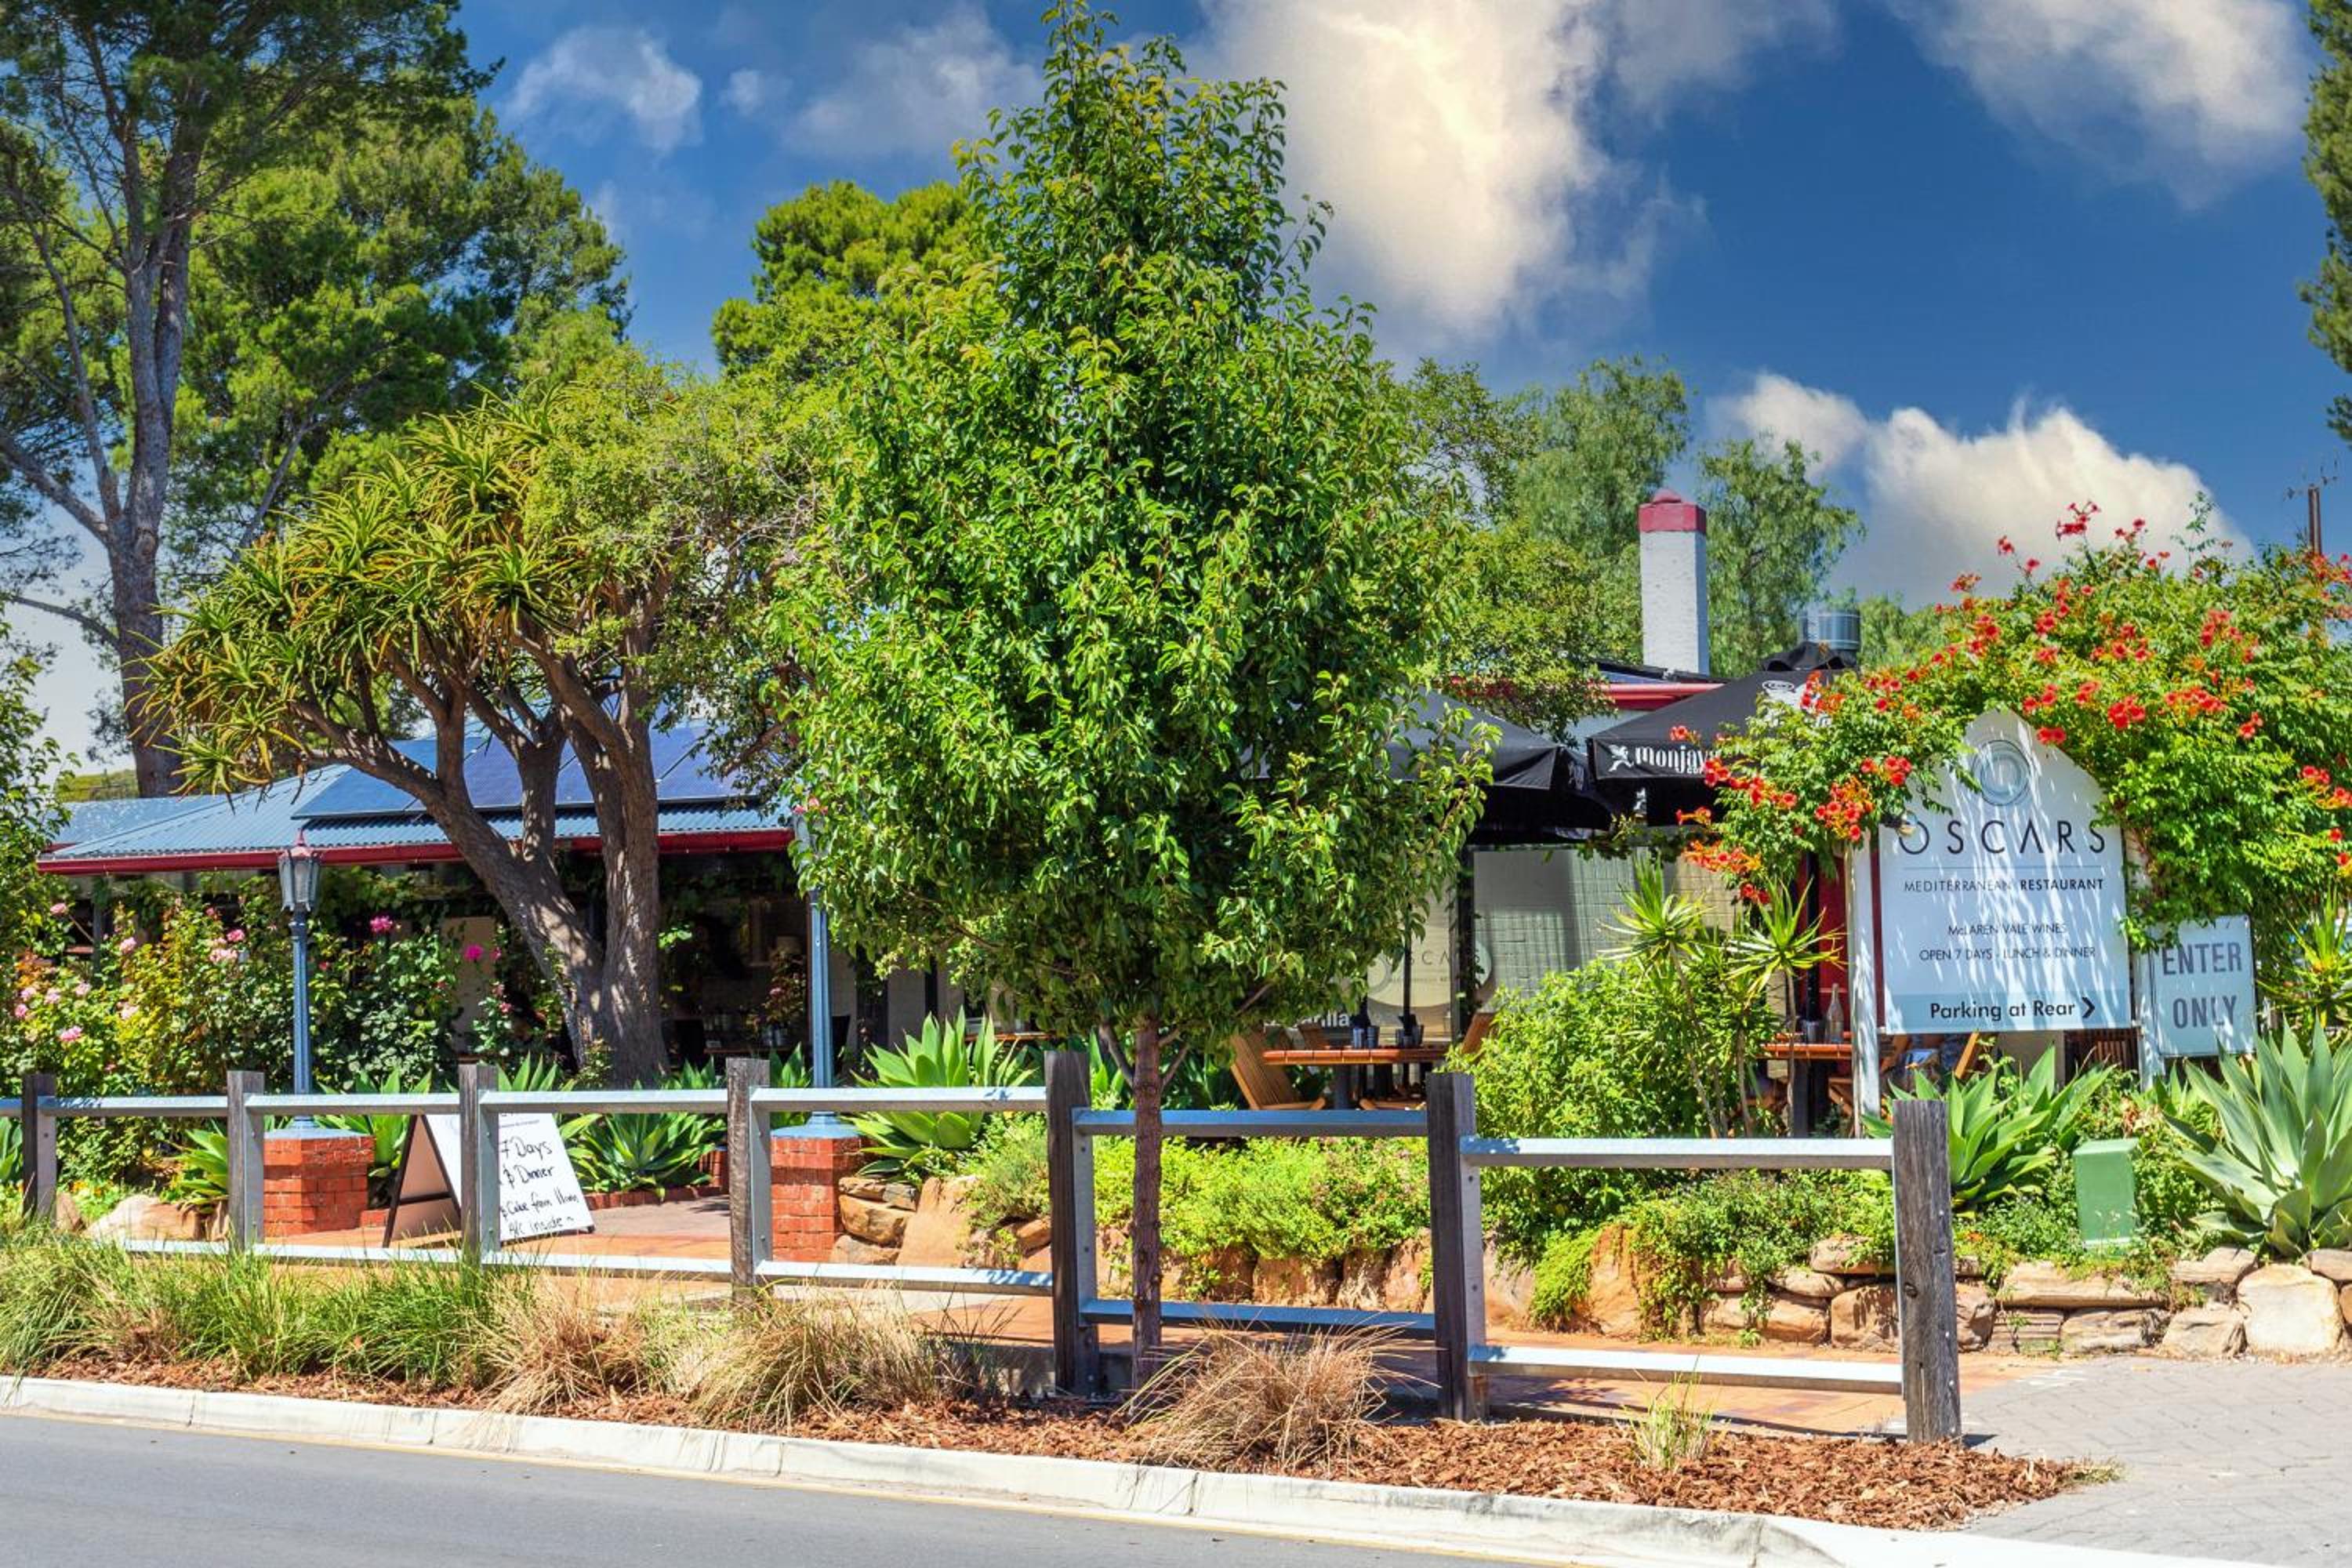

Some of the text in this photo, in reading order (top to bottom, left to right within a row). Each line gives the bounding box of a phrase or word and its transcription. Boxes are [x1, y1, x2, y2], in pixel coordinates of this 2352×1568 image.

[1899, 819, 2105, 855] OSCARS
[1904, 878, 2104, 892] MEDITERRANEAN RESTAURANT
[2003, 924, 2027, 935] VALE
[2031, 923, 2068, 935] WINES
[1919, 949, 1951, 961] OPEN
[1955, 949, 1962, 960] 7
[1965, 948, 1992, 960] DAYS
[2003, 947, 2038, 959] LUNCH
[2056, 946, 2096, 959] DINNER
[2162, 942, 2242, 975] ENTER
[1930, 1000, 2075, 1022] Parking at Rear
[2172, 995, 2238, 1029] ONLY
[510, 1135, 553, 1160] Days
